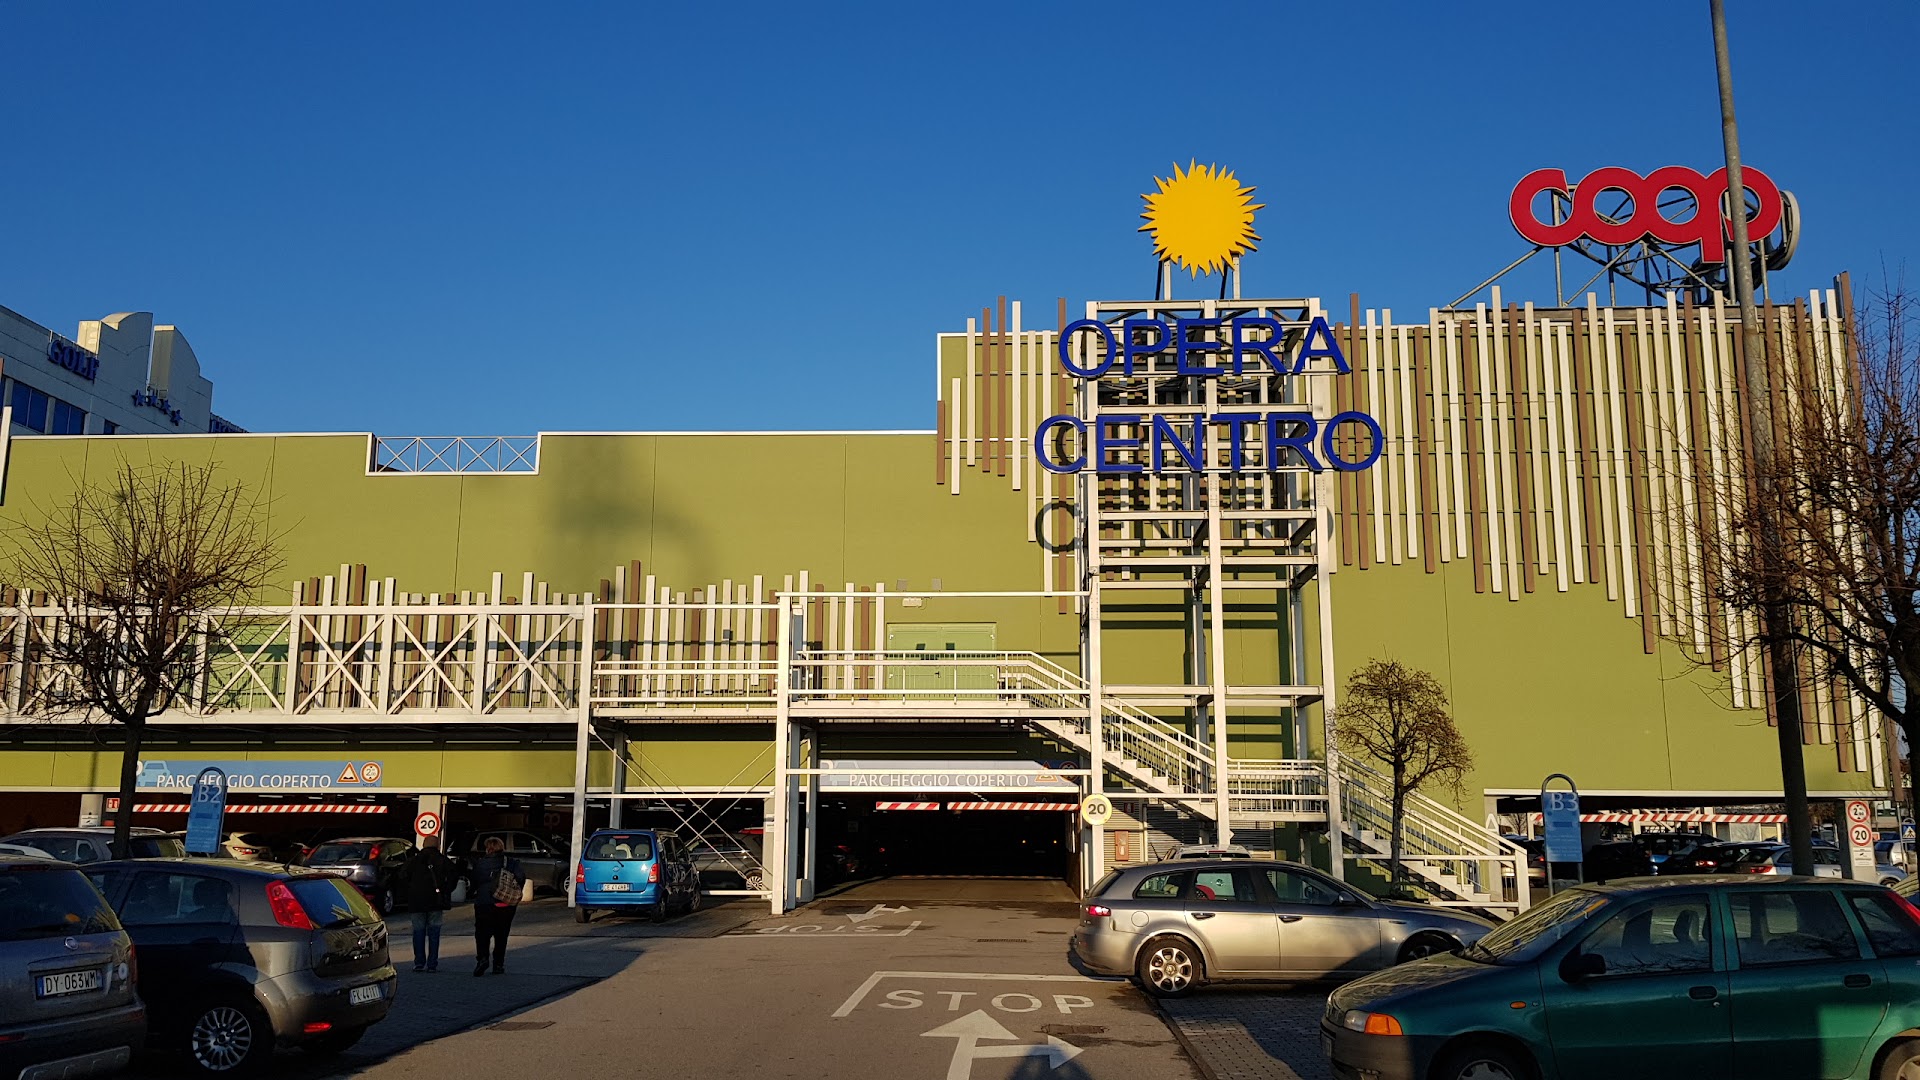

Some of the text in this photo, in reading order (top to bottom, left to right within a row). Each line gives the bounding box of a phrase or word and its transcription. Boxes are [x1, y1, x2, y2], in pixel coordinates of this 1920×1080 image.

[1508, 165, 1783, 263] coop
[1059, 316, 1350, 378] OPERA
[48, 340, 99, 381] GOLF
[1034, 410, 1384, 474] CENTRO
[259, 774, 332, 788] COPERTO
[849, 774, 1029, 787] PARCHEGGIO COPERTO
[197, 784, 222, 803] B2
[1551, 792, 1579, 811] B3
[1088, 803, 1106, 815] 20
[420, 820, 436, 829] 20
[1854, 830, 1867, 841] 20
[756, 924, 883, 934] STOP
[877, 989, 1095, 1014] STOP
